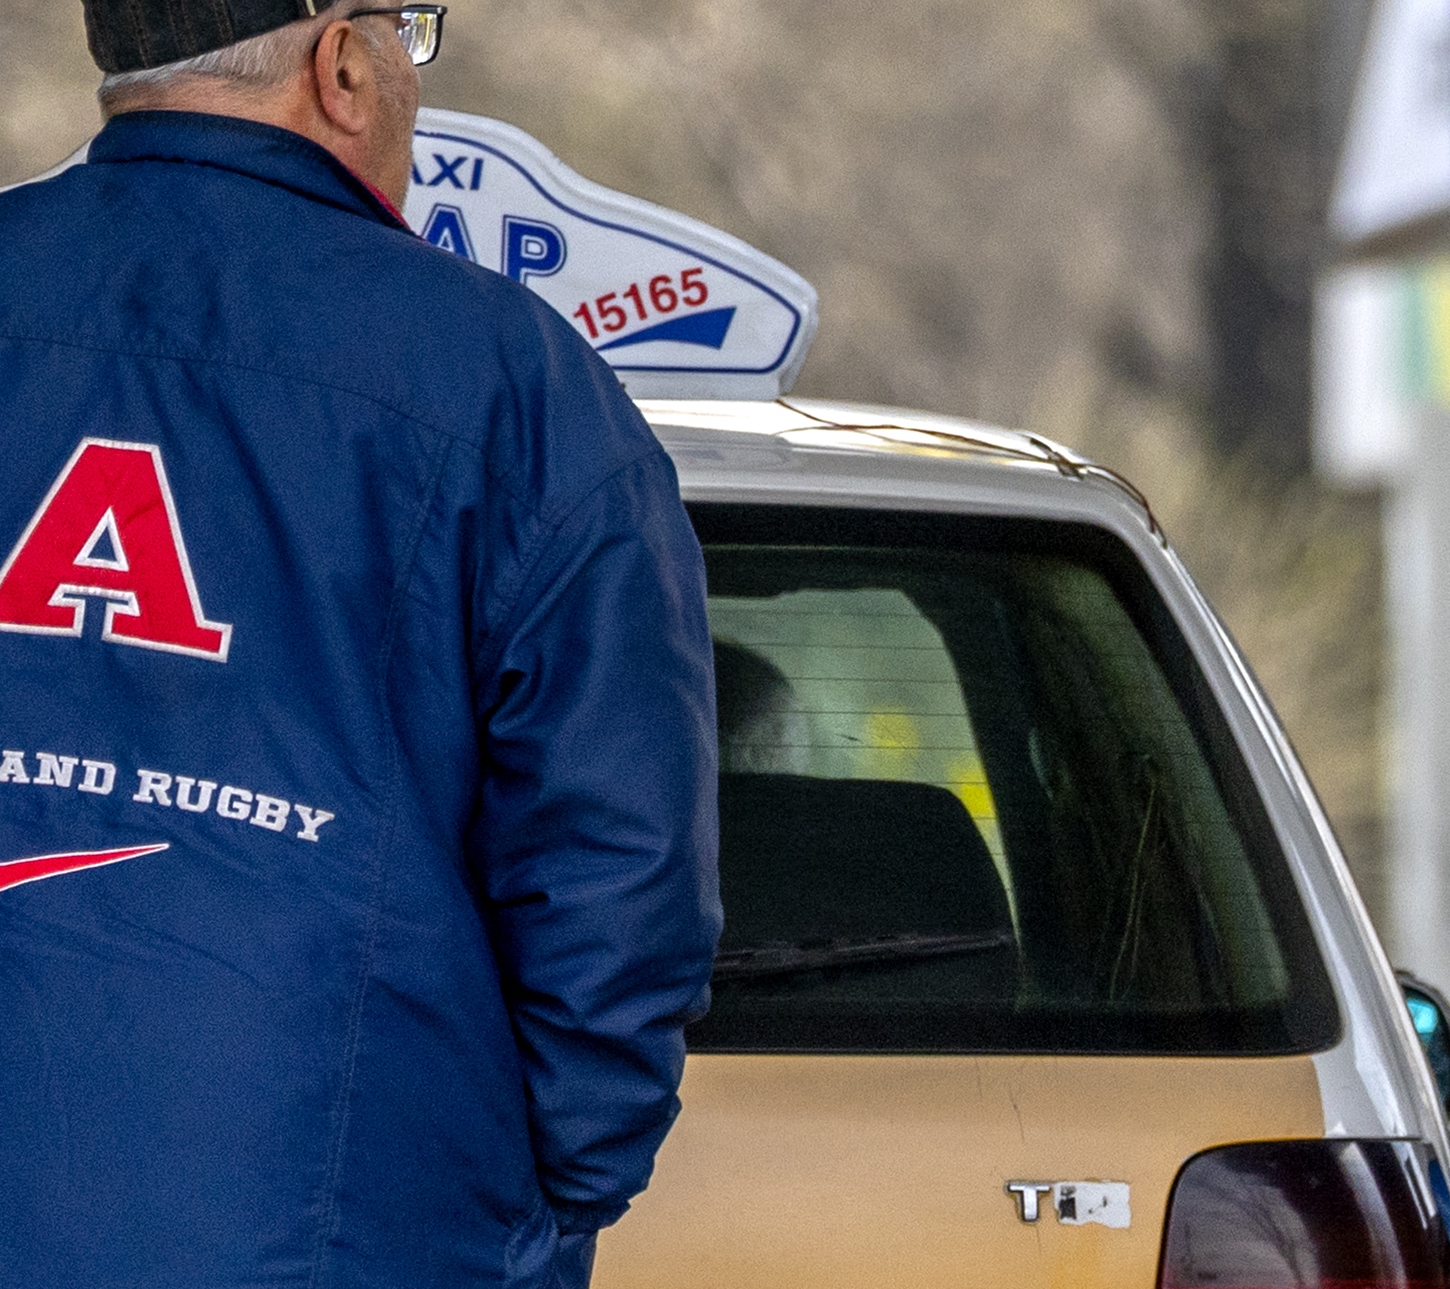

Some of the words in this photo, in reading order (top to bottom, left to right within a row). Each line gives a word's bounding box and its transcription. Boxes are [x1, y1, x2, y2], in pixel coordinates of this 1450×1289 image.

[412, 153, 484, 191] XI
[573, 266, 709, 340] 15165
[132, 768, 335, 842] RUGBY
